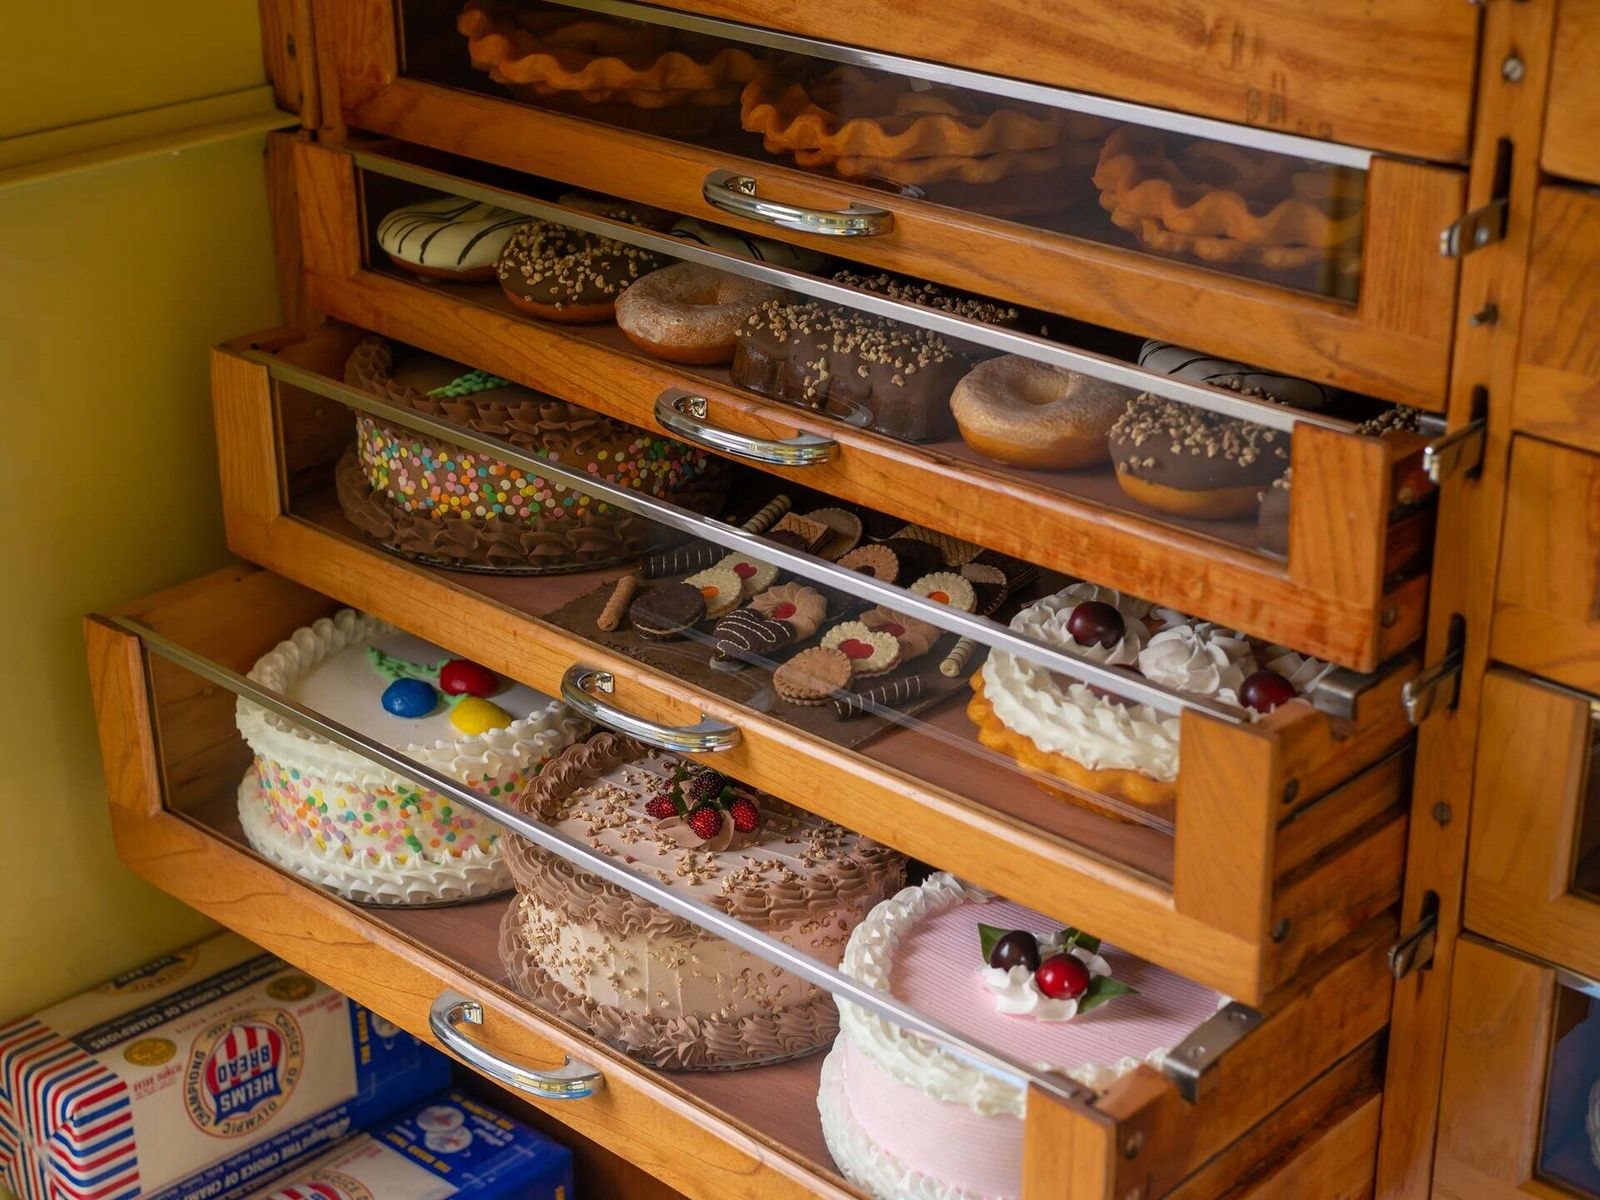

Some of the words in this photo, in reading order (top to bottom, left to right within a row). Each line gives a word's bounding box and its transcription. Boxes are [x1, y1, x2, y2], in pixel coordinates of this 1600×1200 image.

[89, 1014, 164, 1050] CHAMPIONS
[275, 1013, 300, 1056] CHOICE
[217, 1044, 271, 1083] BREAD
[285, 1067, 298, 1085] OF
[188, 1050, 212, 1127] CHAMPIONS
[220, 1072, 275, 1112] HELMS
[222, 1101, 278, 1134] OLYMPIC
[224, 1171, 239, 1188] OF
[240, 1152, 280, 1179] CHOICE
